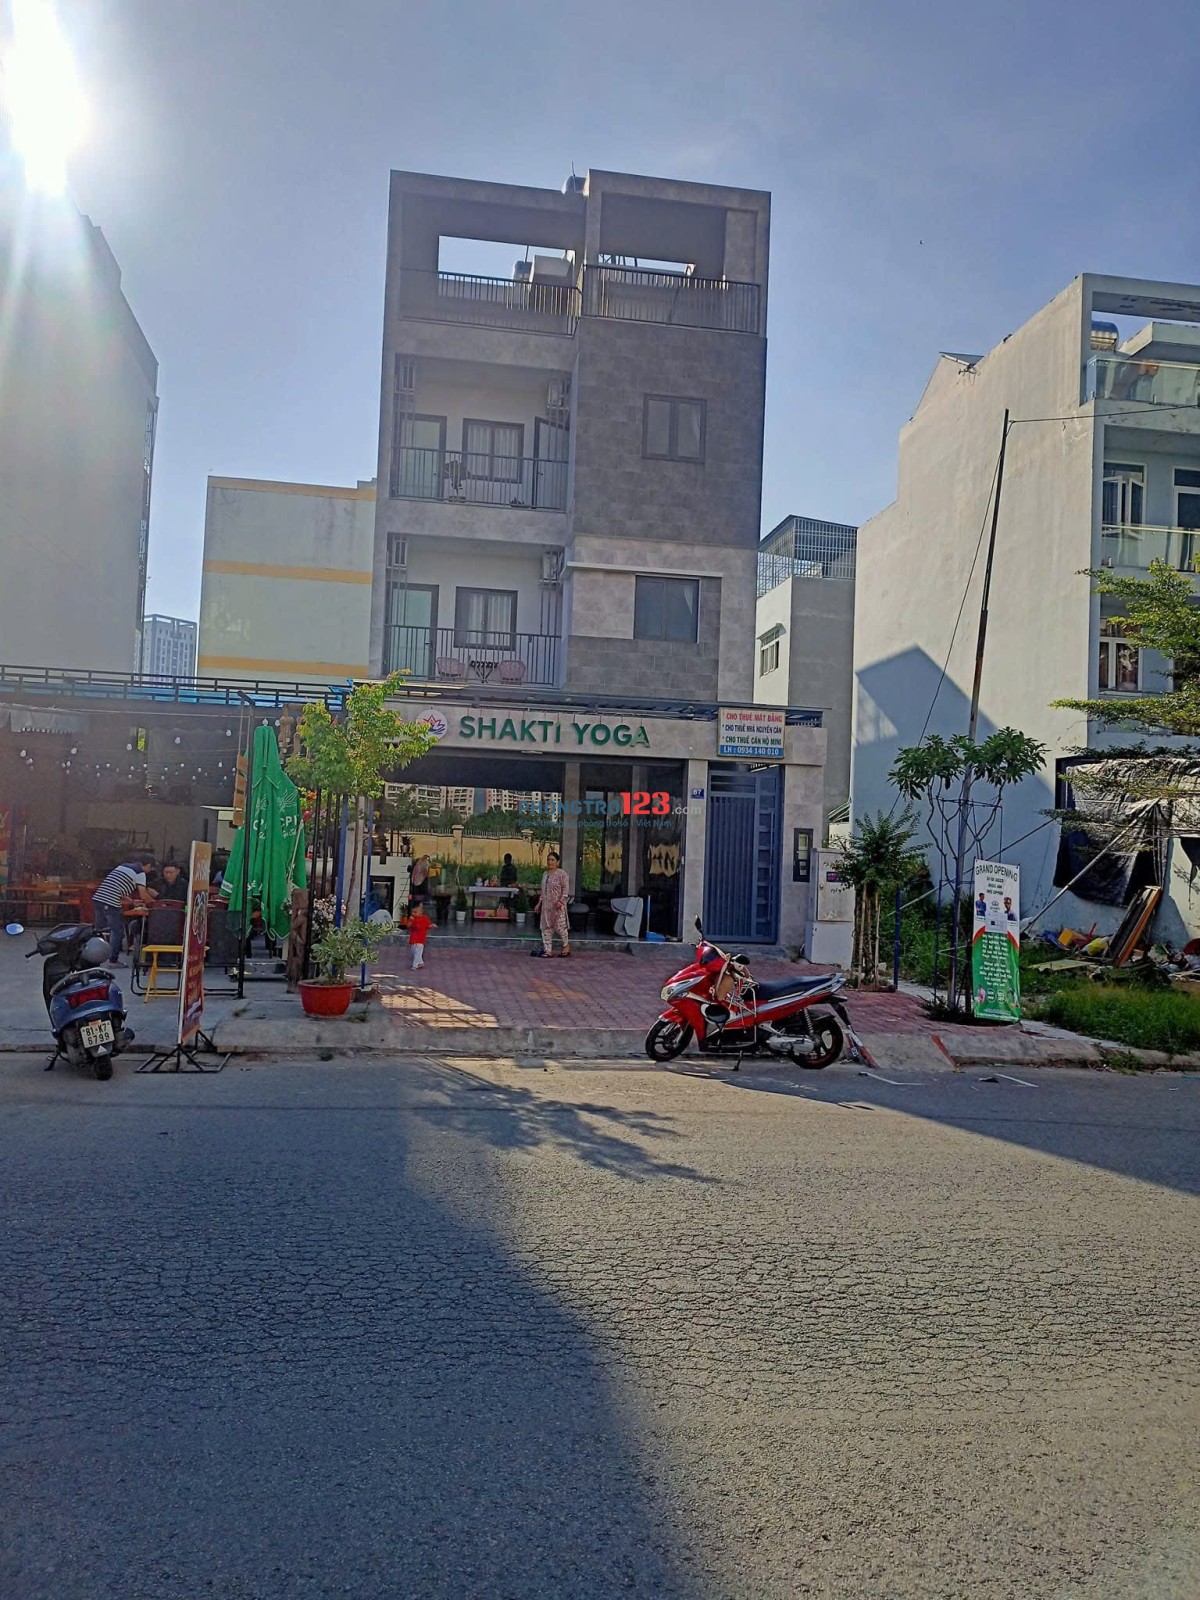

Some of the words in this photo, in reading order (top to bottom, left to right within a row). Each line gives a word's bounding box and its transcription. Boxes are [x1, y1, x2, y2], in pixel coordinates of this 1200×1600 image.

[739, 712, 752, 721] THUÊ
[459, 715, 561, 744] SHAKTI
[572, 722, 651, 748] YOGA
[725, 724, 734, 732] CHO
[735, 724, 745, 732] THUÊ
[737, 735, 749, 744] THUÊ
[770, 738, 782, 746] MINI
[737, 746, 752, 754] 0934
[754, 747, 765, 755] 140
[975, 864, 994, 876] GRAND
[993, 864, 1018, 882] OPENING
